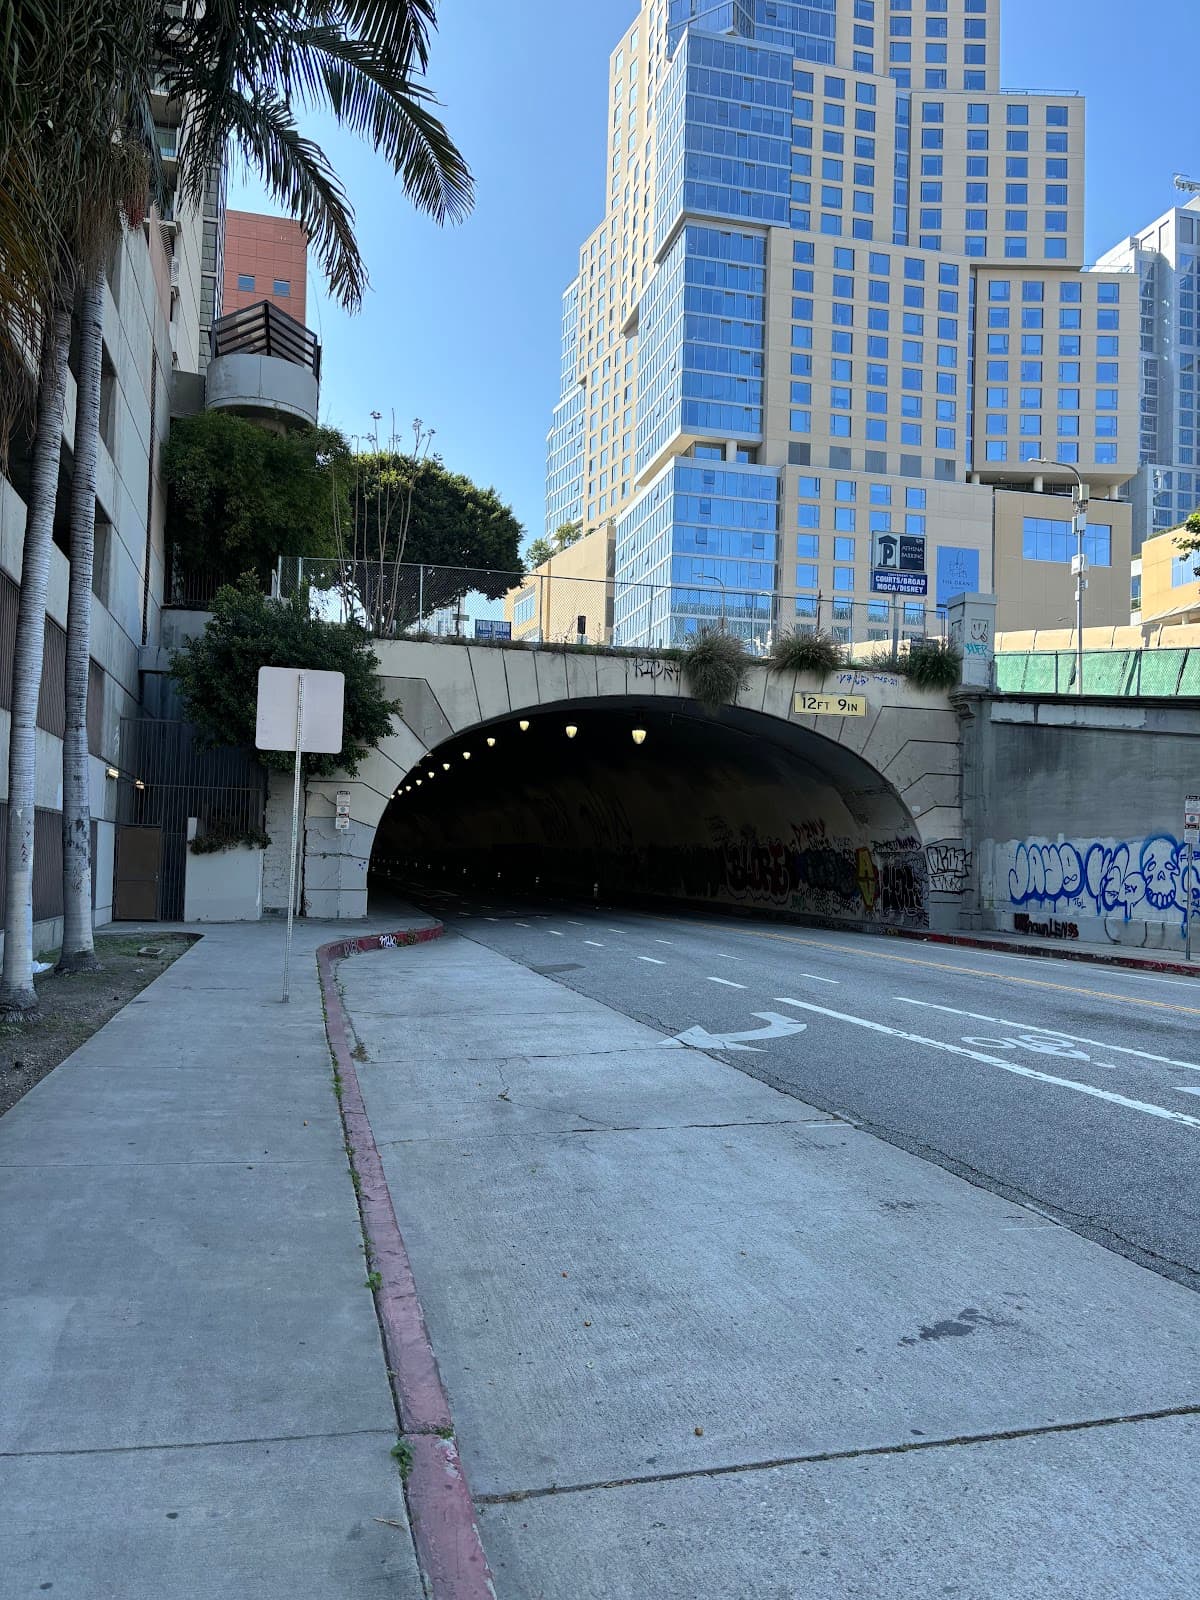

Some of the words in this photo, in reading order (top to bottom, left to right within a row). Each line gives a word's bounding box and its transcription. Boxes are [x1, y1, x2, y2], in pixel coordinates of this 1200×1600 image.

[901, 552, 924, 560] PARKING
[875, 575, 926, 586] COURTS/BROAD
[876, 583, 924, 594] MOCA/DISNEY
[802, 697, 830, 711] 12FT
[838, 698, 858, 712] 9IN
